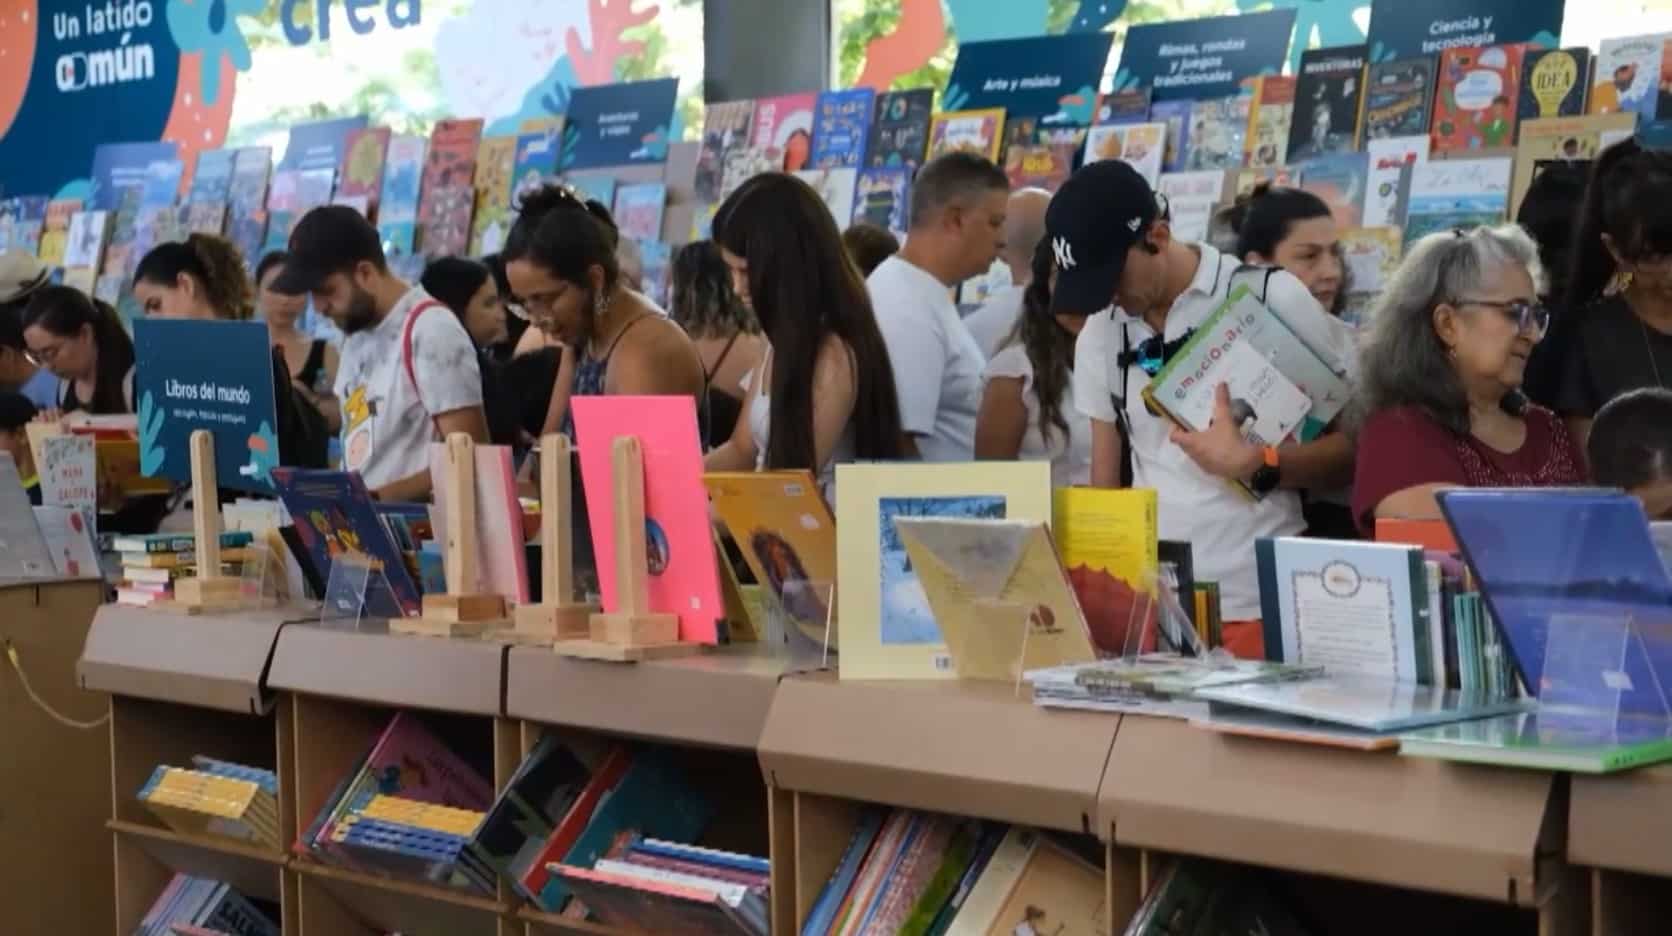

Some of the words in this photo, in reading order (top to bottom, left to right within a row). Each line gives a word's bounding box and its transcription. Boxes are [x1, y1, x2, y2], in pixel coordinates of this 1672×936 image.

[54, 12, 80, 40] Un
[86, 0, 152, 35] latido
[1429, 16, 1480, 35] Ciencia
[1483, 16, 1493, 31] y
[1202, 39, 1246, 53] rondas
[1180, 57, 1222, 73] juegos
[983, 78, 1008, 91] Arte
[1009, 79, 1018, 92] y
[1020, 74, 1061, 89] música
[1153, 72, 1233, 88] tradicionales
[165, 379, 198, 400] Libros
[200, 381, 216, 400] del
[218, 384, 250, 405] mundo
